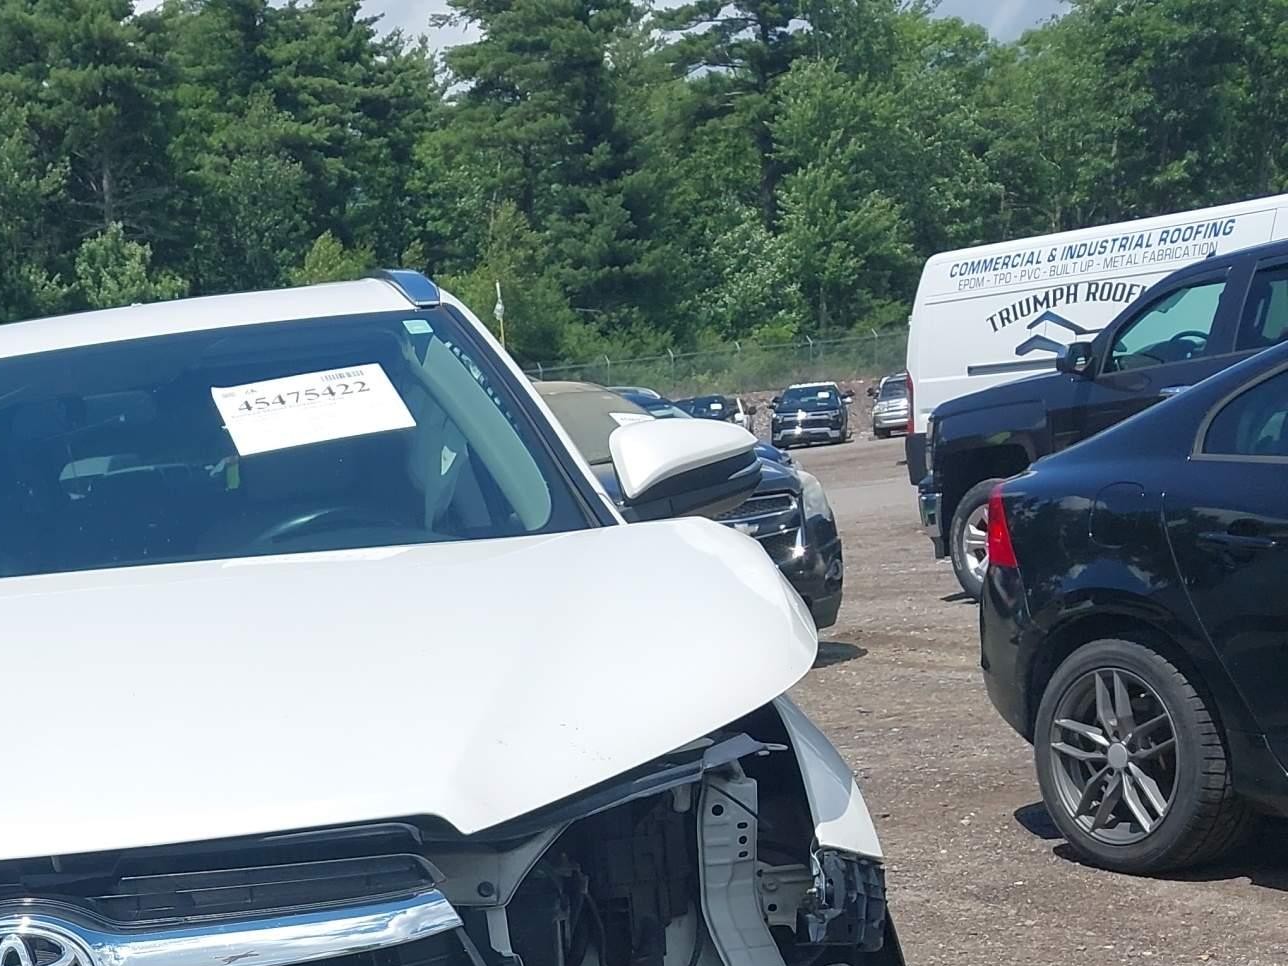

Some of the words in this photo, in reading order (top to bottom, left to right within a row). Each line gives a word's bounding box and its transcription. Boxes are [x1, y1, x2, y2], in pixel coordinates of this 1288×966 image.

[949, 249, 1042, 278] COMMERCIAL
[1047, 247, 1058, 263] &
[1060, 231, 1153, 261] INDUSTRIAL
[1157, 219, 1236, 247] ROOFING
[958, 276, 985, 291] EPDM
[993, 271, 1012, 285] TPO
[1019, 267, 1041, 281] PVC
[1048, 259, 1078, 277] BUILT
[1079, 259, 1094, 273] UP
[1102, 252, 1139, 270] METAL
[1142, 241, 1218, 263] FABRICATION
[985, 282, 1079, 333] TRIUMPH
[237, 380, 371, 411] 45475422
